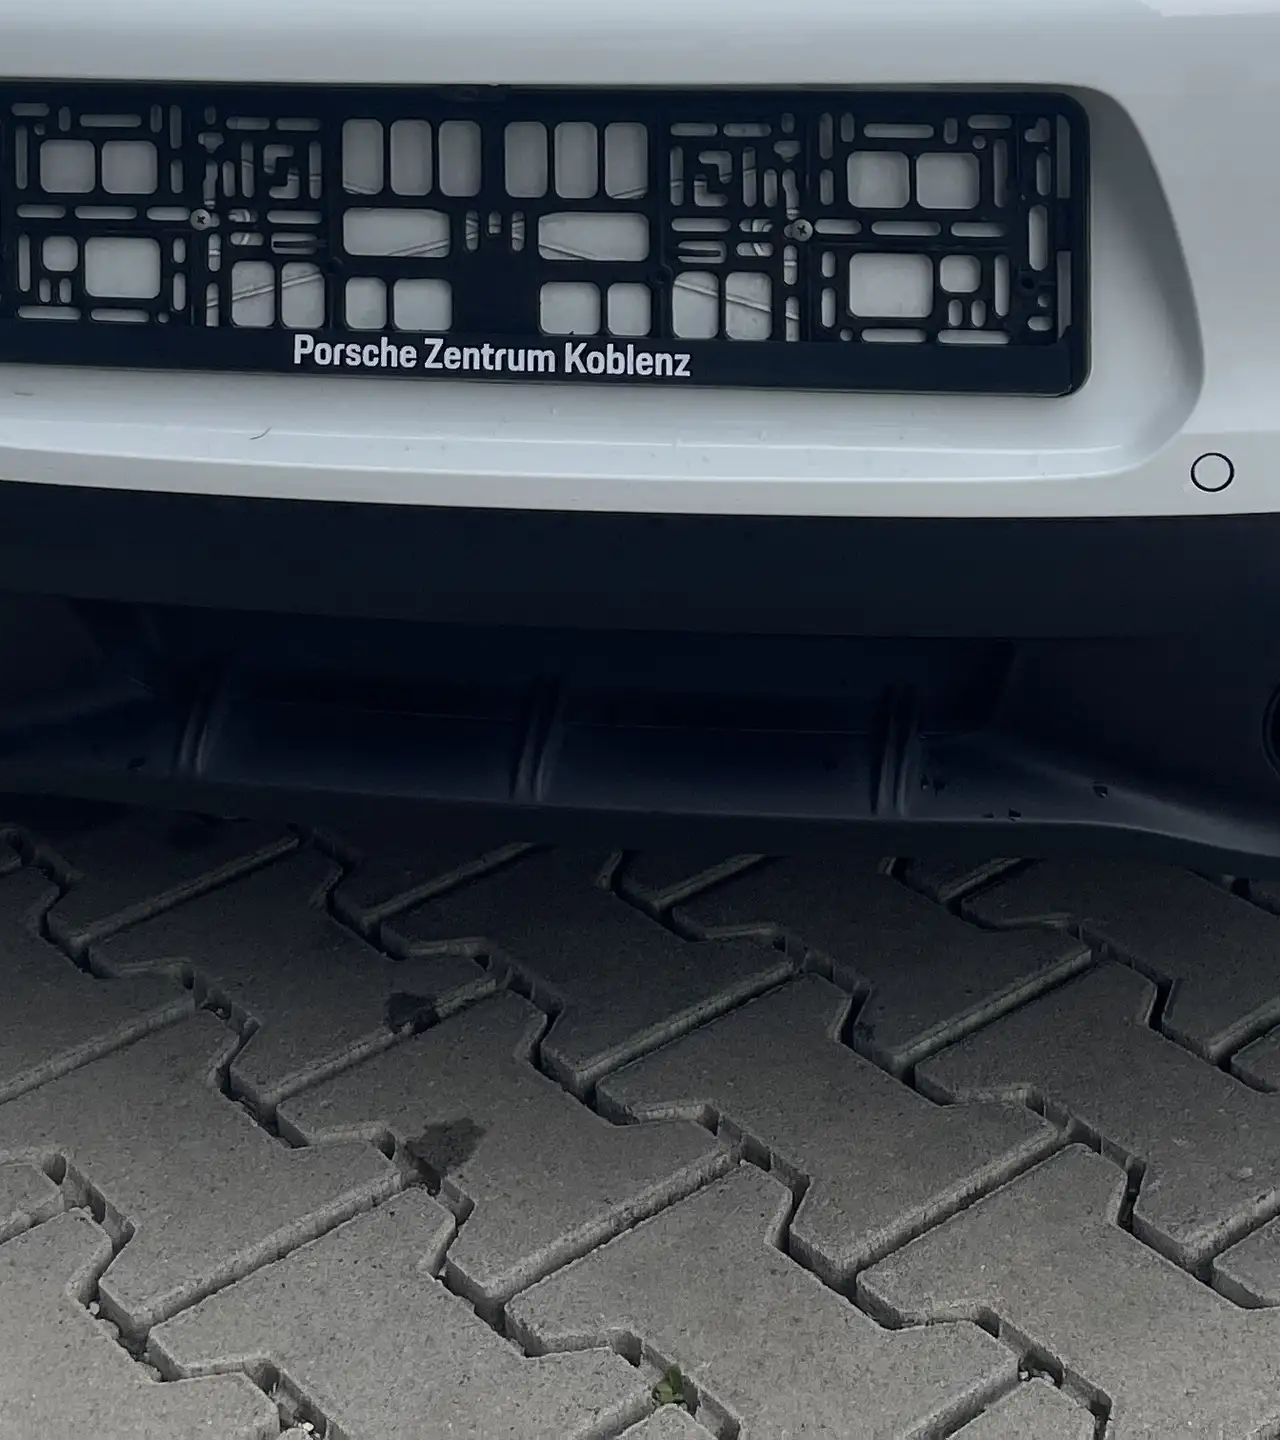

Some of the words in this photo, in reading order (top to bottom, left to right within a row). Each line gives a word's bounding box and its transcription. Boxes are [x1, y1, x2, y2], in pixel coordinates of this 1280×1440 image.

[293, 333, 417, 368] Porsche
[424, 337, 555, 372] Zentrum
[564, 341, 691, 377] Koblenz
